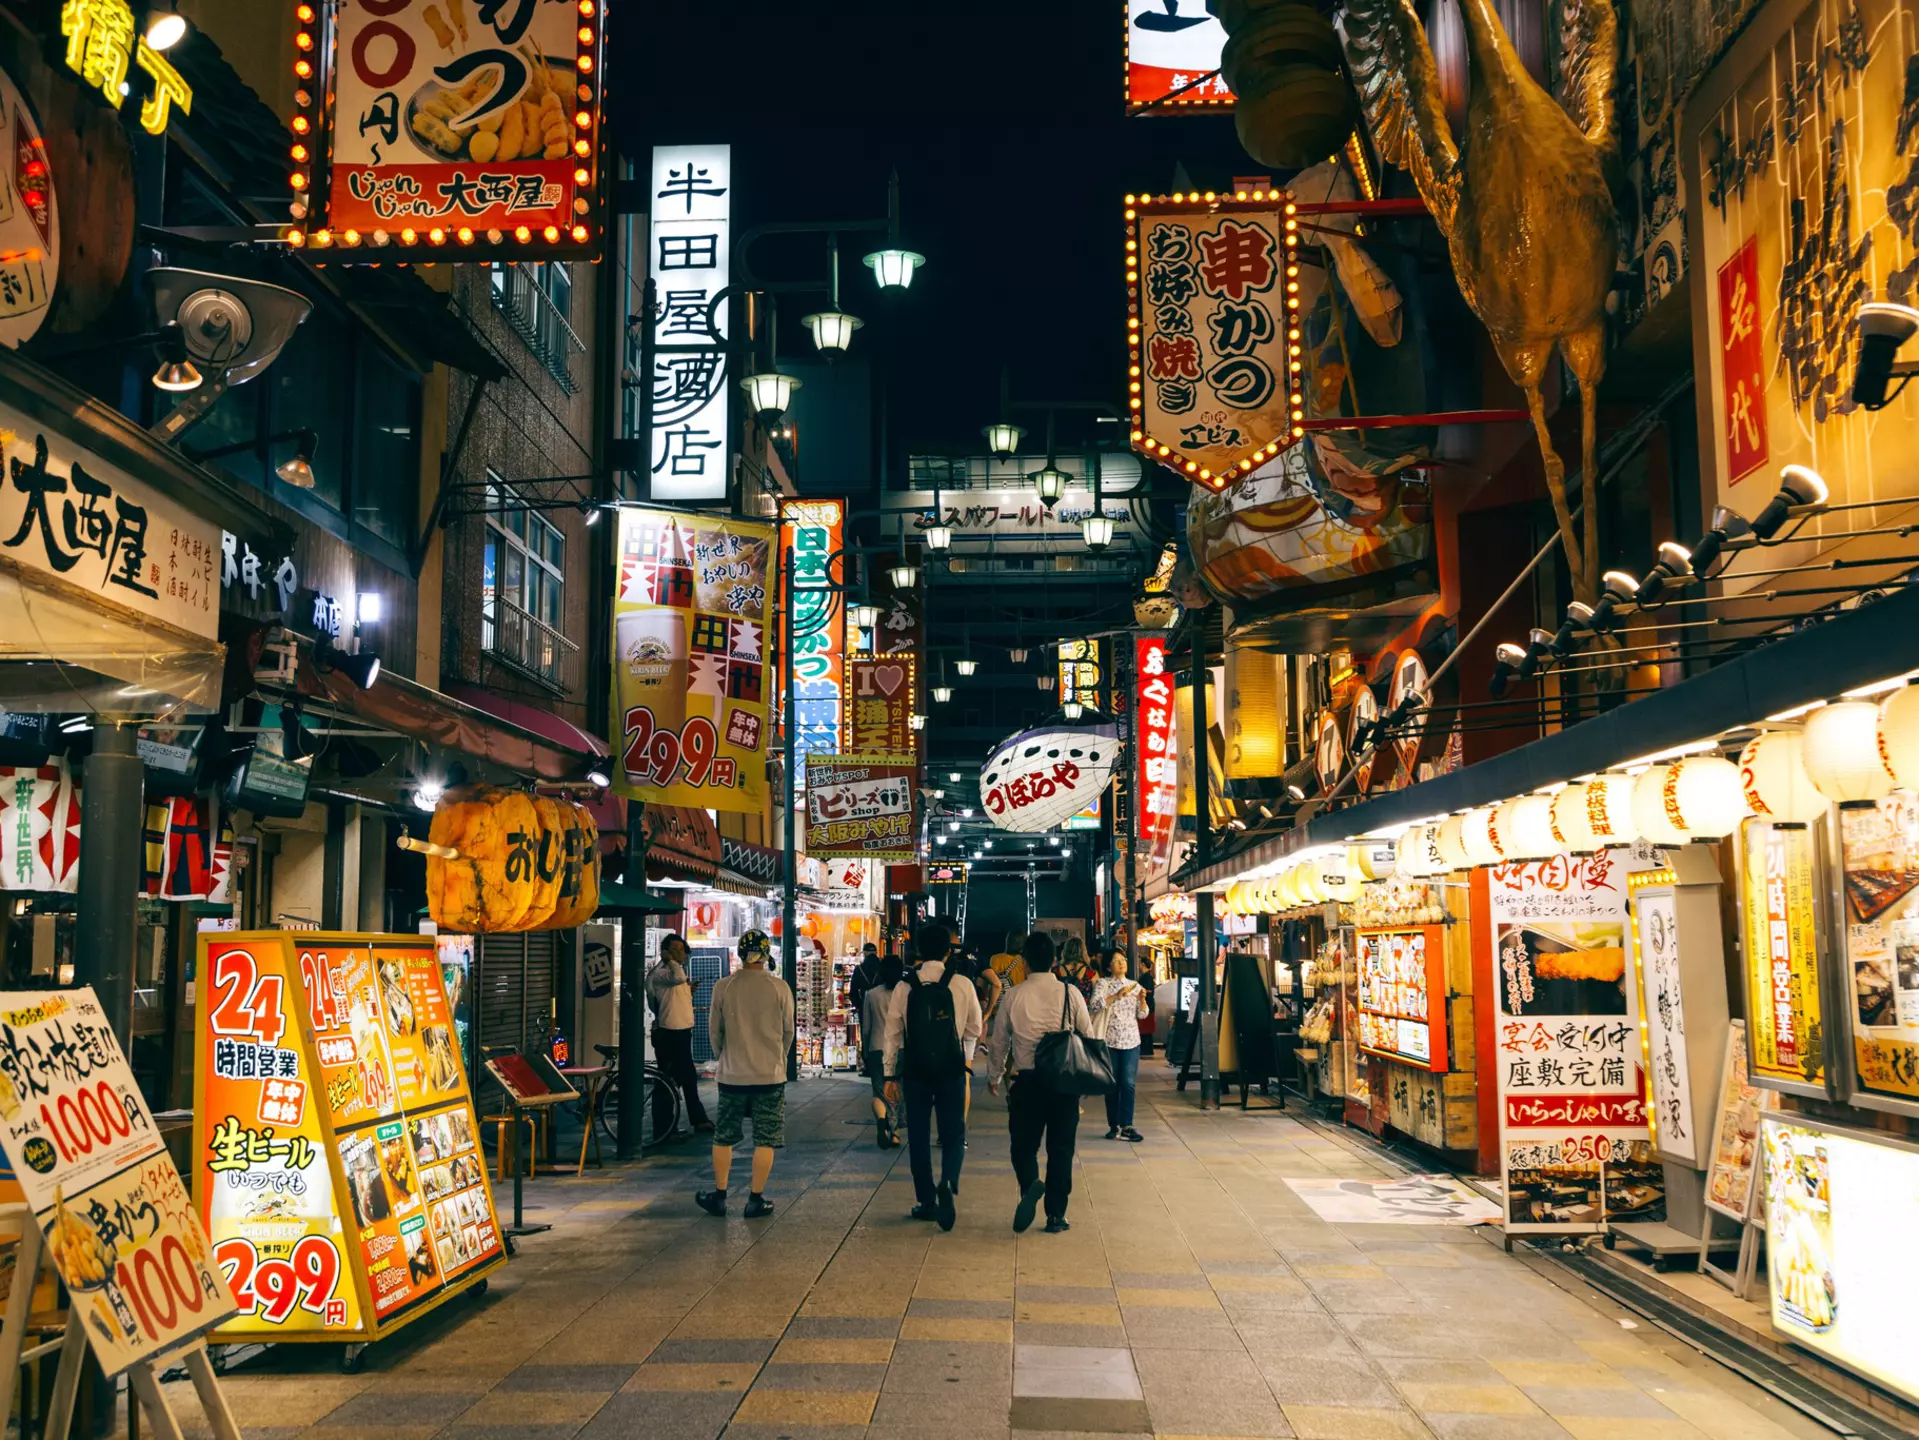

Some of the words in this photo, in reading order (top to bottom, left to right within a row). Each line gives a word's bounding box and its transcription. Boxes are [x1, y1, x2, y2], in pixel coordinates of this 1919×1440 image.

[436, 173, 555, 215] 大西屋
[651, 162, 728, 475] 半田屋酒店
[1149, 225, 1202, 411] お好み焼き
[1201, 224, 1268, 404] 串かつ
[3, 433, 159, 600] 大西屋
[624, 705, 736, 789] 299円
[986, 761, 1080, 815] づぼらや
[807, 814, 911, 846] 大阪みやげ
[210, 949, 286, 1047] 24
[215, 1037, 299, 1081] 時間営業
[1507, 1056, 1626, 1087] 座敷完備
[208, 1116, 315, 1172] 生ビール
[228, 1169, 307, 1196] いつでも
